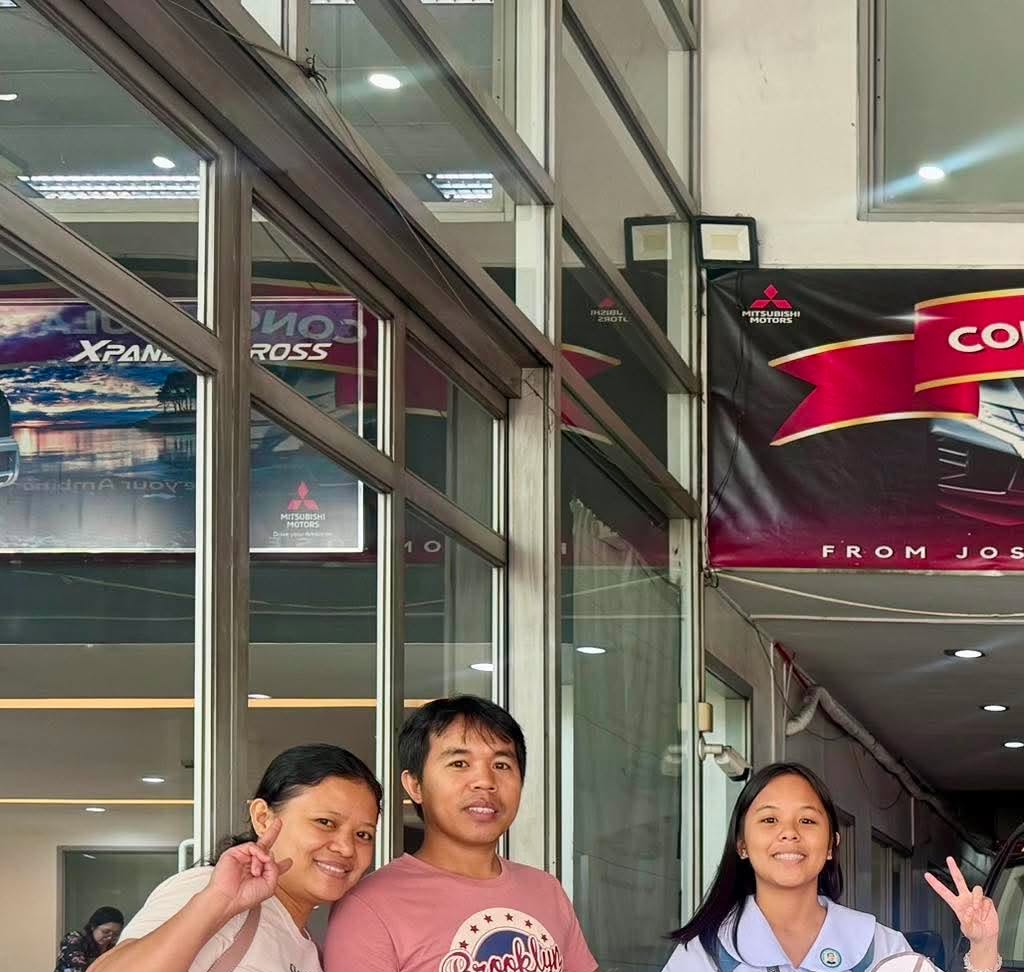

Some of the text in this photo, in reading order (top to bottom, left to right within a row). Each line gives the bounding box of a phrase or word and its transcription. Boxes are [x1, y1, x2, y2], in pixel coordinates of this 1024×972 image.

[66, 339, 333, 362] XPAN ROSS
[280, 512, 326, 521] MITSUBISHI
[286, 521, 320, 529] MOTORS
[822, 545, 926, 559] FROM
